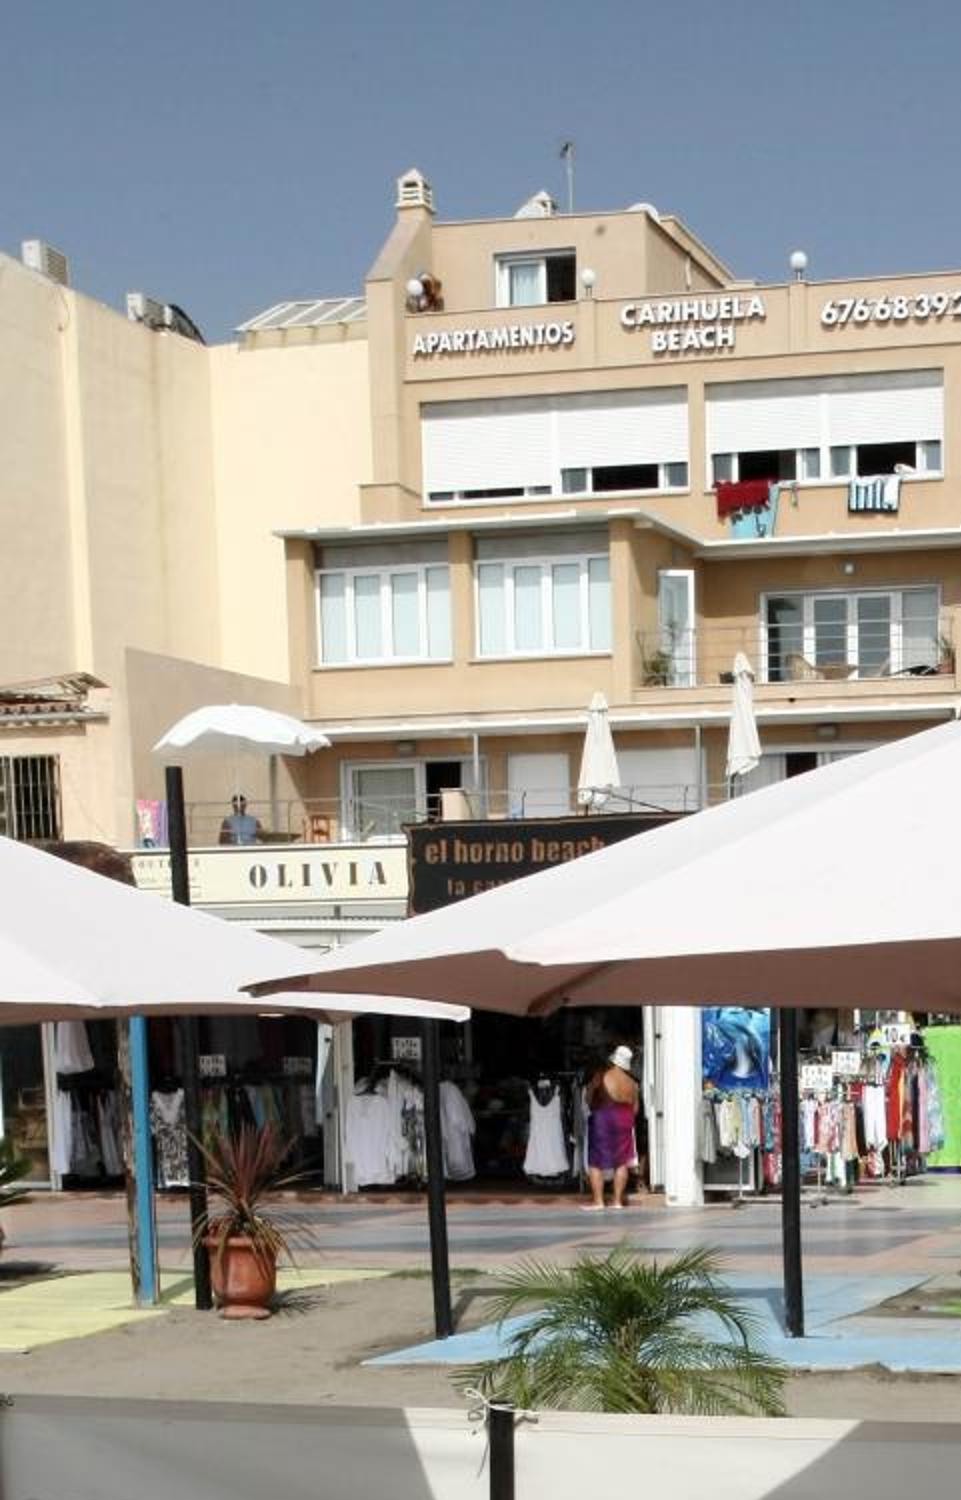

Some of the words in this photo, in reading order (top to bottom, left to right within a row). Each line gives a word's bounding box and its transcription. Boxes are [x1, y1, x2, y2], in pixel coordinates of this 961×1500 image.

[620, 296, 766, 328] CARIHUELA
[414, 321, 575, 354] APARTAMENTOS
[651, 325, 736, 353] BEACH
[425, 838, 446, 864] el
[453, 837, 524, 863] horno
[250, 861, 387, 889] OLIVIA
